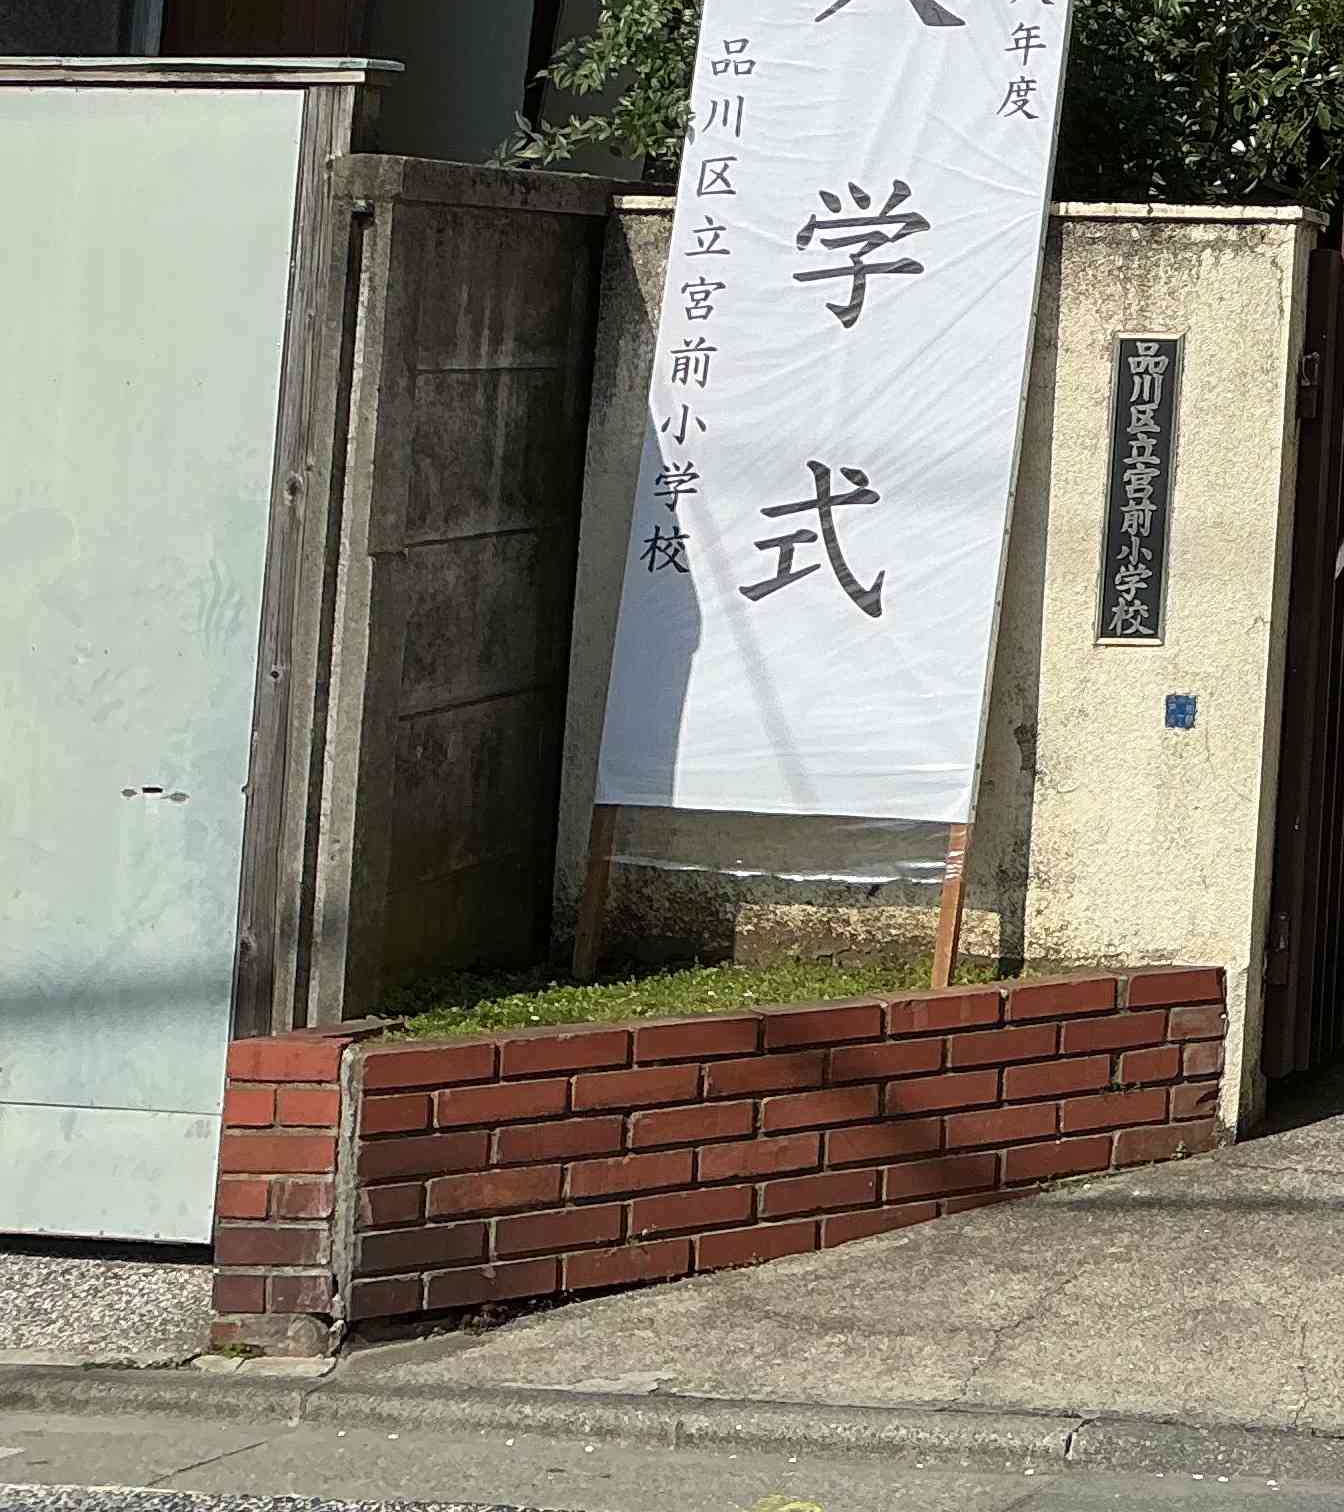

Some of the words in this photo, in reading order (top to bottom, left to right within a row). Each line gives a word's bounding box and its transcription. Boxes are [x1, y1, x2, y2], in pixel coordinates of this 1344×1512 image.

[640, 37, 757, 575] 品川区立宮前小学校
[1108, 340, 1169, 637] 品川区立宮前小学校
